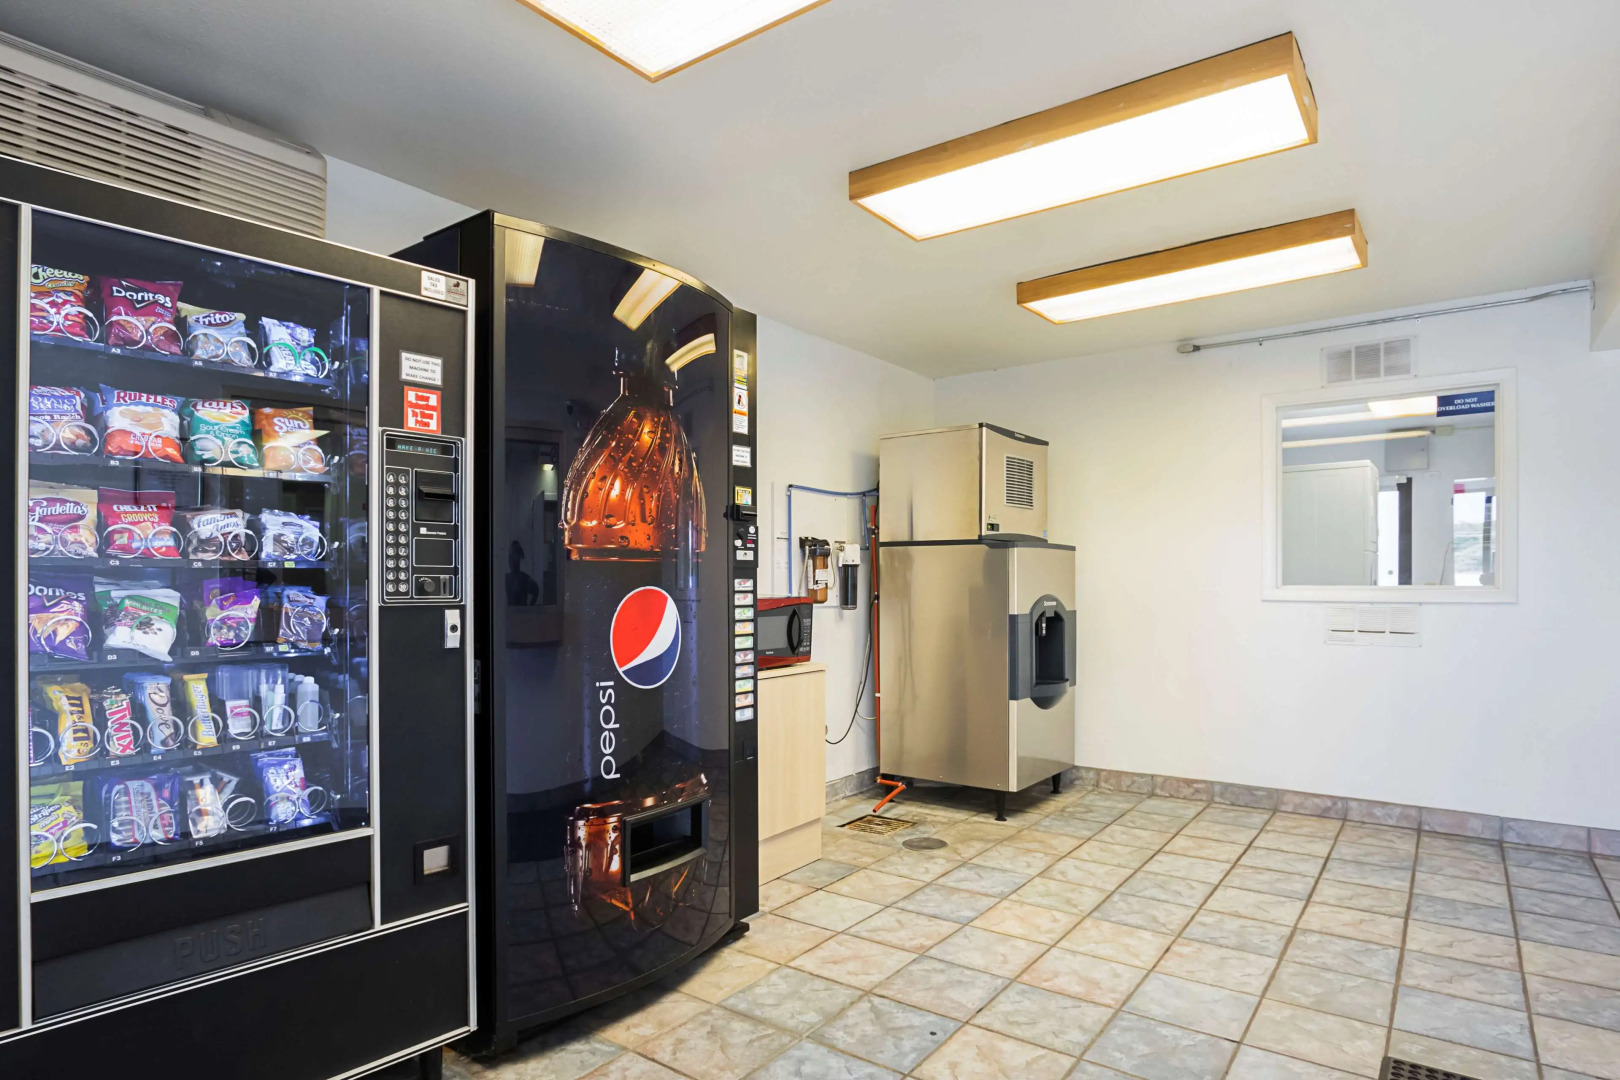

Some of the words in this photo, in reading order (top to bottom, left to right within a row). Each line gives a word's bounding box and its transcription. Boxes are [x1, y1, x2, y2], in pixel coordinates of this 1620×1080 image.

[31, 266, 84, 284] Cheetos
[112, 286, 172, 308] Doritos
[194, 311, 237, 327] Fritos
[409, 365, 429, 373] MACHINE
[115, 391, 177, 409] RUFFLES
[196, 399, 243, 413] Lay's
[1437, 403, 1470, 411] OVERLOAD
[199, 423, 219, 432] Sour
[220, 425, 246, 435] Cream
[273, 416, 309, 433] Sun
[217, 429, 239, 439] Onion
[113, 504, 158, 512] CHEEZ-IT
[194, 513, 238, 529] Famous
[212, 519, 241, 533] Amos
[193, 684, 214, 738] Butterfinger
[596, 681, 620, 780] pepsi
[174, 917, 268, 971] PUSH
